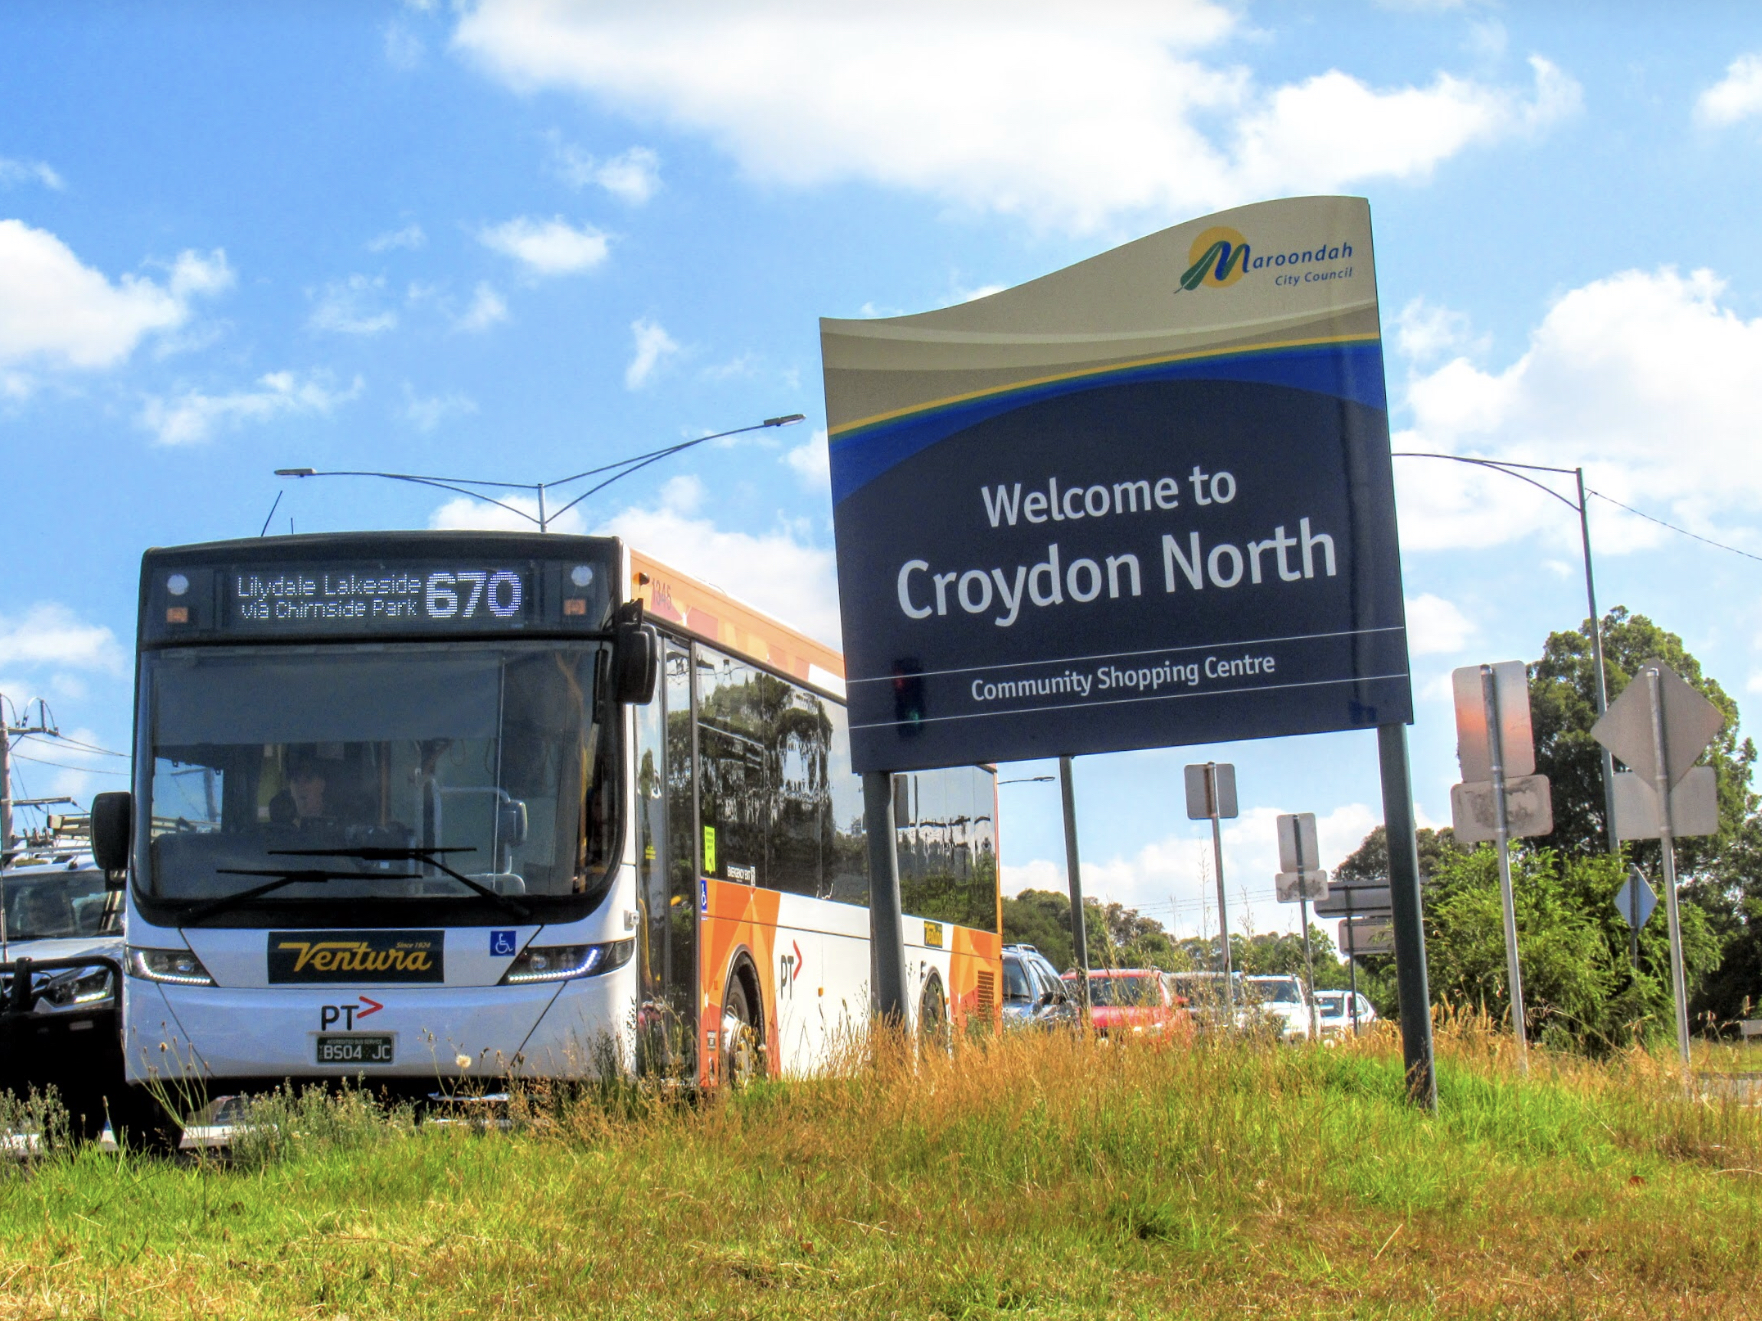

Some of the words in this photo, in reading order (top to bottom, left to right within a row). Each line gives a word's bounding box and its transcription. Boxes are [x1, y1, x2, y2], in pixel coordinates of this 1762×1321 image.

[1175, 239, 1353, 294] Maroondah
[1275, 274, 1301, 287] City
[1304, 267, 1353, 283] Council
[981, 477, 1179, 528] Welcome
[1189, 465, 1237, 505] to
[238, 575, 316, 602] Lilydale
[325, 574, 421, 595] Lakeside
[897, 544, 1141, 628] Croydon
[1162, 517, 1337, 594] North
[242, 601, 269, 618] via
[276, 599, 366, 618] Chirnside
[373, 598, 417, 616] Park
[426, 571, 522, 618] 670
[971, 668, 1092, 703] Community
[1097, 659, 1199, 690] Shopping
[1204, 653, 1276, 679] Centre
[278, 941, 432, 972] Ventura
[321, 1005, 360, 1031] PT
[372, 1045, 390, 1059] JC
